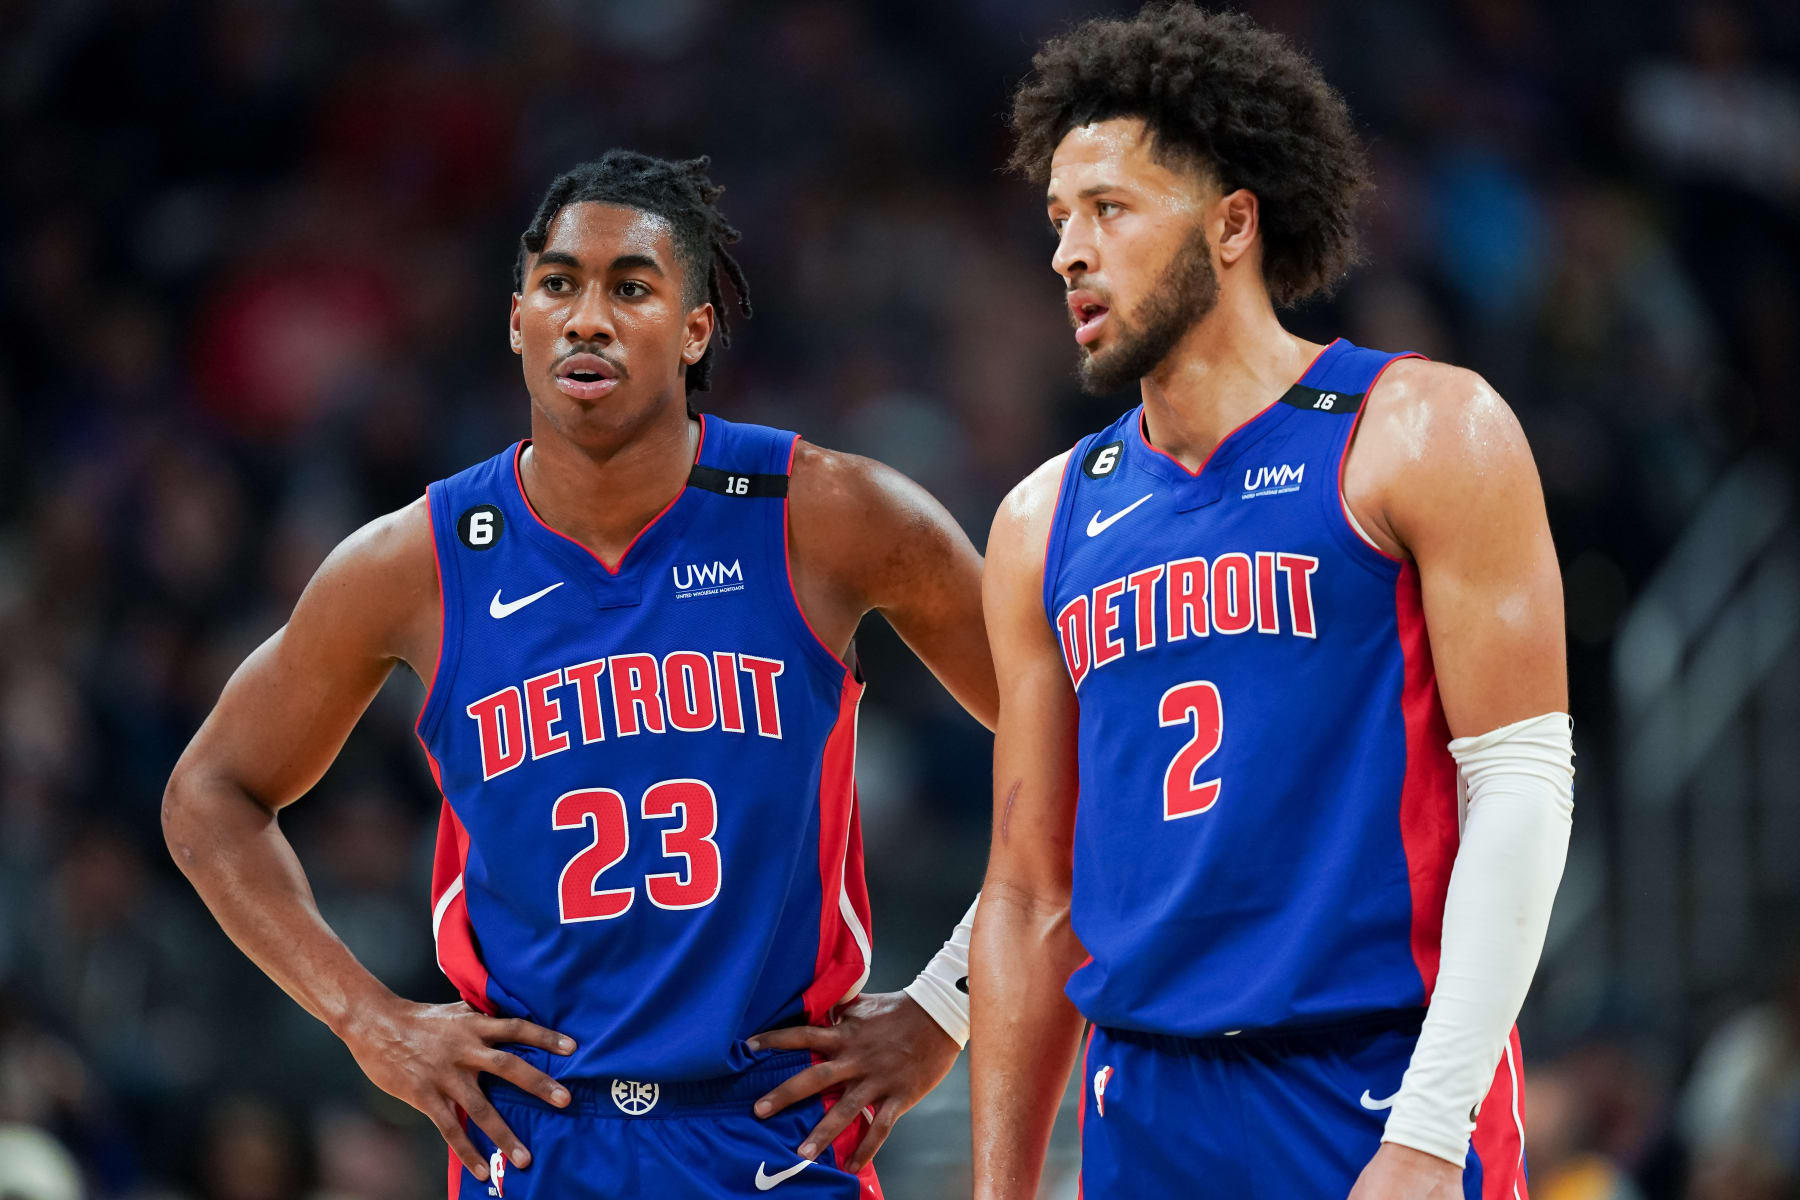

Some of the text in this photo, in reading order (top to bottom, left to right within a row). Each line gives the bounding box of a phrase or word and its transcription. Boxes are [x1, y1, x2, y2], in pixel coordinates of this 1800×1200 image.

[1313, 393, 1337, 410] 16
[1091, 445, 1120, 475] 6
[1244, 462, 1305, 491] UWM
[725, 476, 750, 495] 16
[469, 511, 494, 545] 6
[672, 558, 744, 590] UWM
[1056, 550, 1320, 694] DETROIT
[465, 650, 785, 782] DETROIT
[1158, 680, 1224, 822] 2
[551, 778, 722, 925] 23
